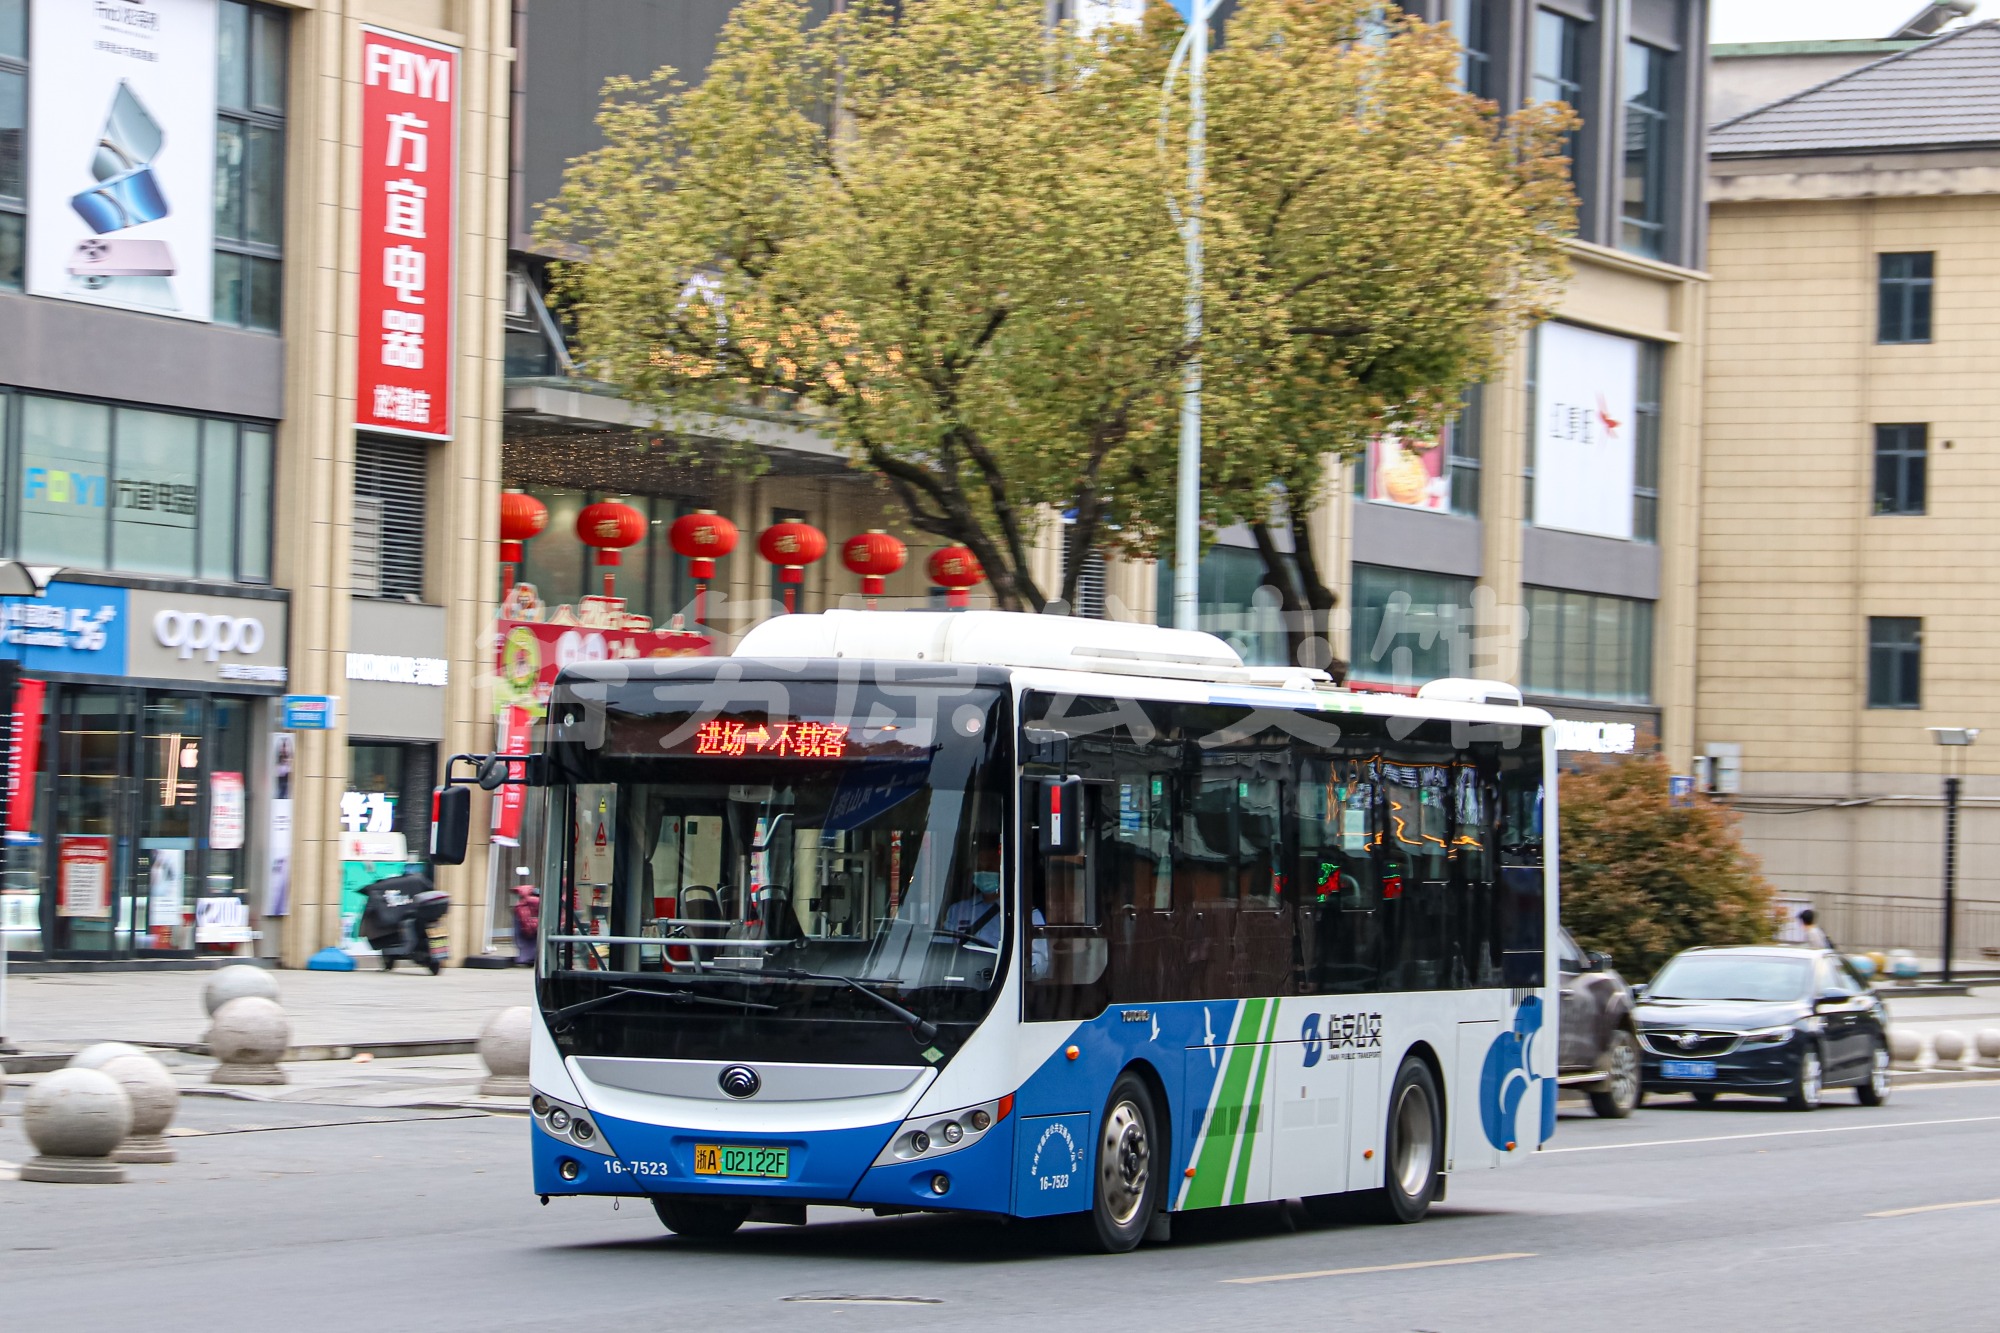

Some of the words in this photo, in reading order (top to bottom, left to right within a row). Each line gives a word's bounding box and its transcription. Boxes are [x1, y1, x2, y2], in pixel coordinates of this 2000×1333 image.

[365, 43, 450, 102] FOYI
[380, 112, 430, 369] 方宜电器
[23, 467, 107, 507] FOYI
[112, 478, 197, 515] 方宜电器
[1327, 1012, 1382, 1049] 临安公交
[603, 1160, 669, 1176] 16-7523
[1040, 1173, 1069, 1190] 16-7523
